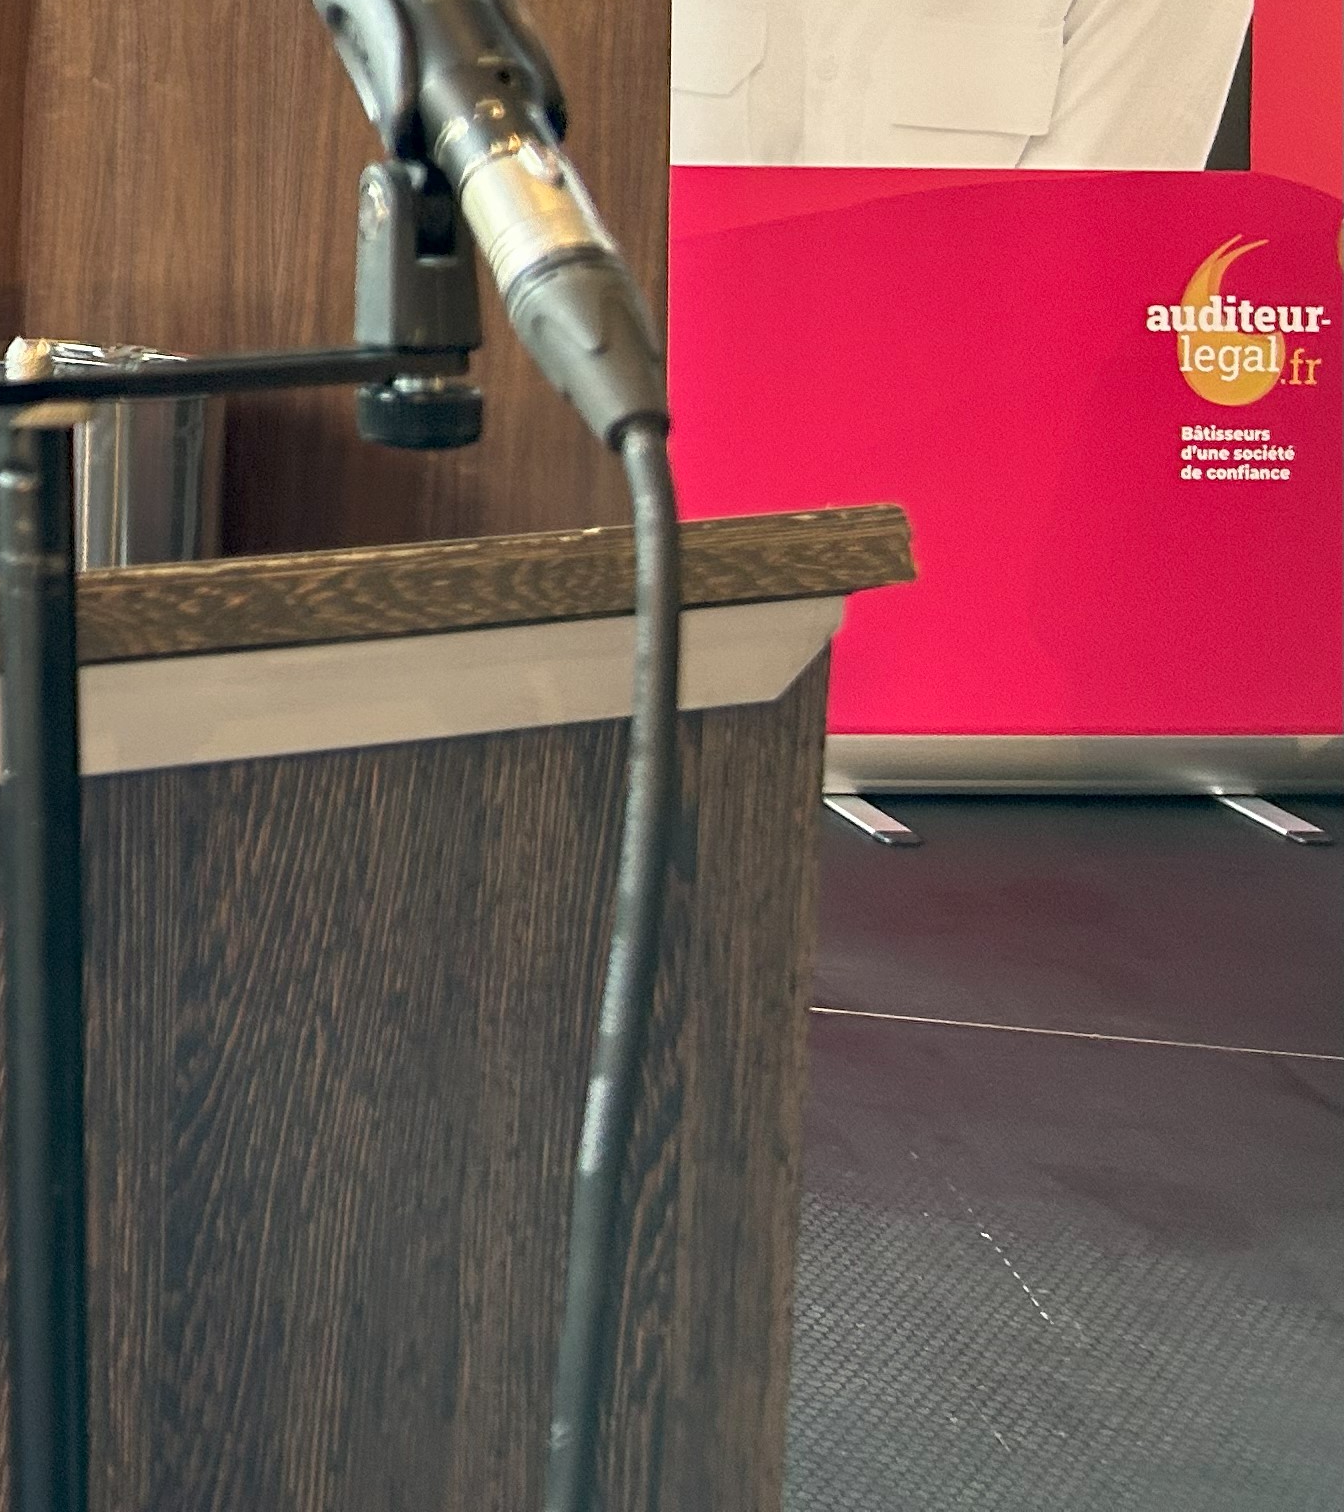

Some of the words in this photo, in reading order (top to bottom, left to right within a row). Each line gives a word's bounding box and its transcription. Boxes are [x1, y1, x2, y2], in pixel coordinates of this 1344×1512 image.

[1146, 295, 1332, 333] auditeur-
[1180, 425, 1271, 442] Bâtisseurs
[1180, 445, 1230, 461] d'une
[1233, 445, 1295, 461] société
[1180, 464, 1203, 481] de
[1206, 464, 1291, 481] confiance
